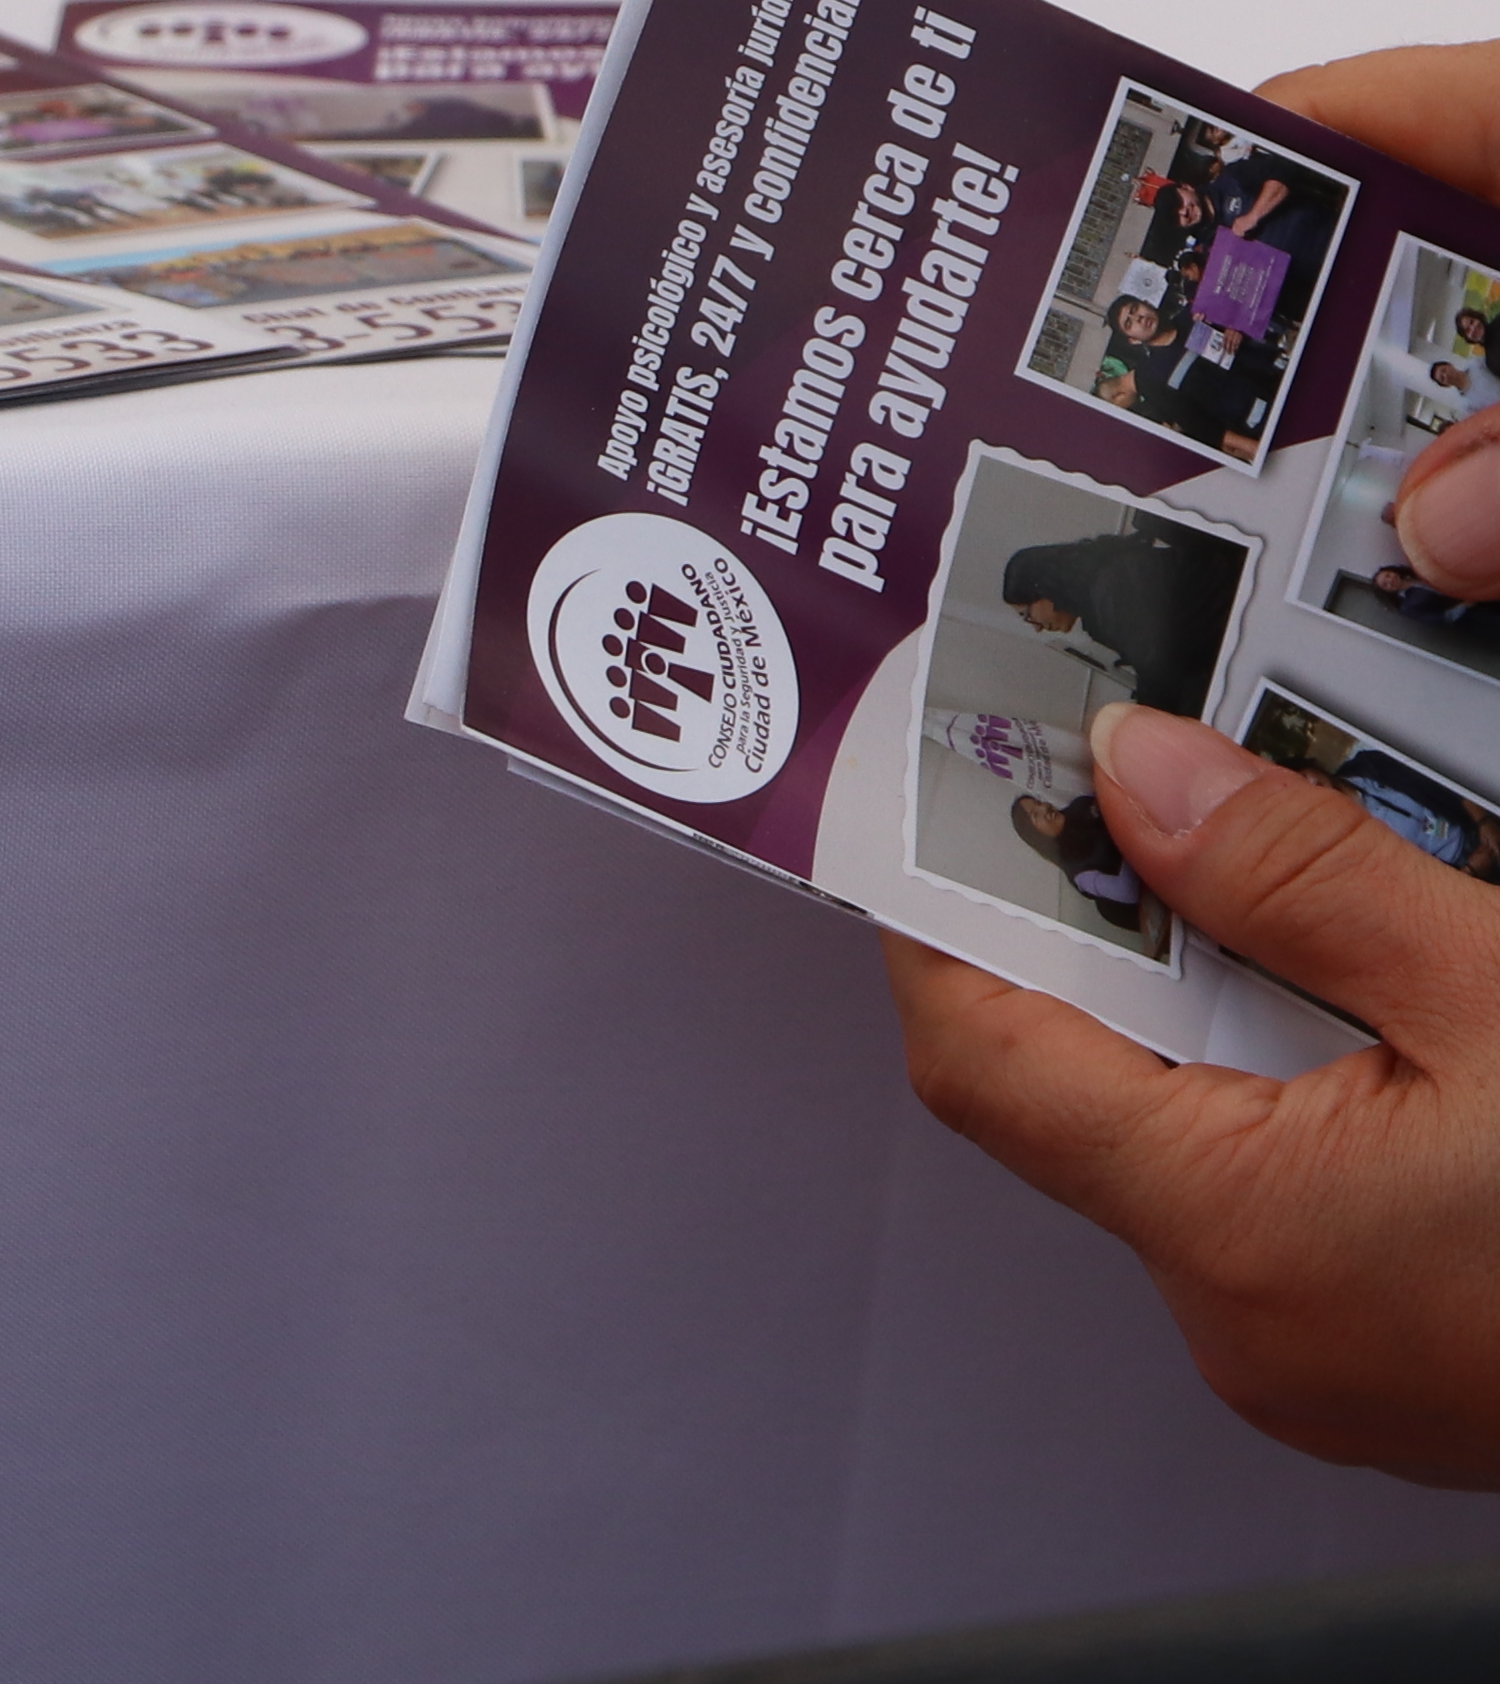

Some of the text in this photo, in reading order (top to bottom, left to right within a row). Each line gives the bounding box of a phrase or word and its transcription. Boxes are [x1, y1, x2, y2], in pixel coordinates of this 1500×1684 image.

[686, 192, 719, 221] y
[696, 66, 765, 194] asesoría
[627, 219, 707, 391] psicológico
[646, 366, 729, 507] ¡GRATIS,
[691, 254, 756, 358] 24/7
[729, 223, 774, 261] y
[740, 5, 976, 555] ¡Estamos cerca de ti
[818, 142, 1019, 593] para ayudarte!
[597, 390, 648, 481] Apoyo
[681, 562, 738, 770] CONSEJO CIUDADANO
[704, 570, 754, 756] para la Seguridad y Justicia
[713, 557, 772, 775] Ciudad de México
